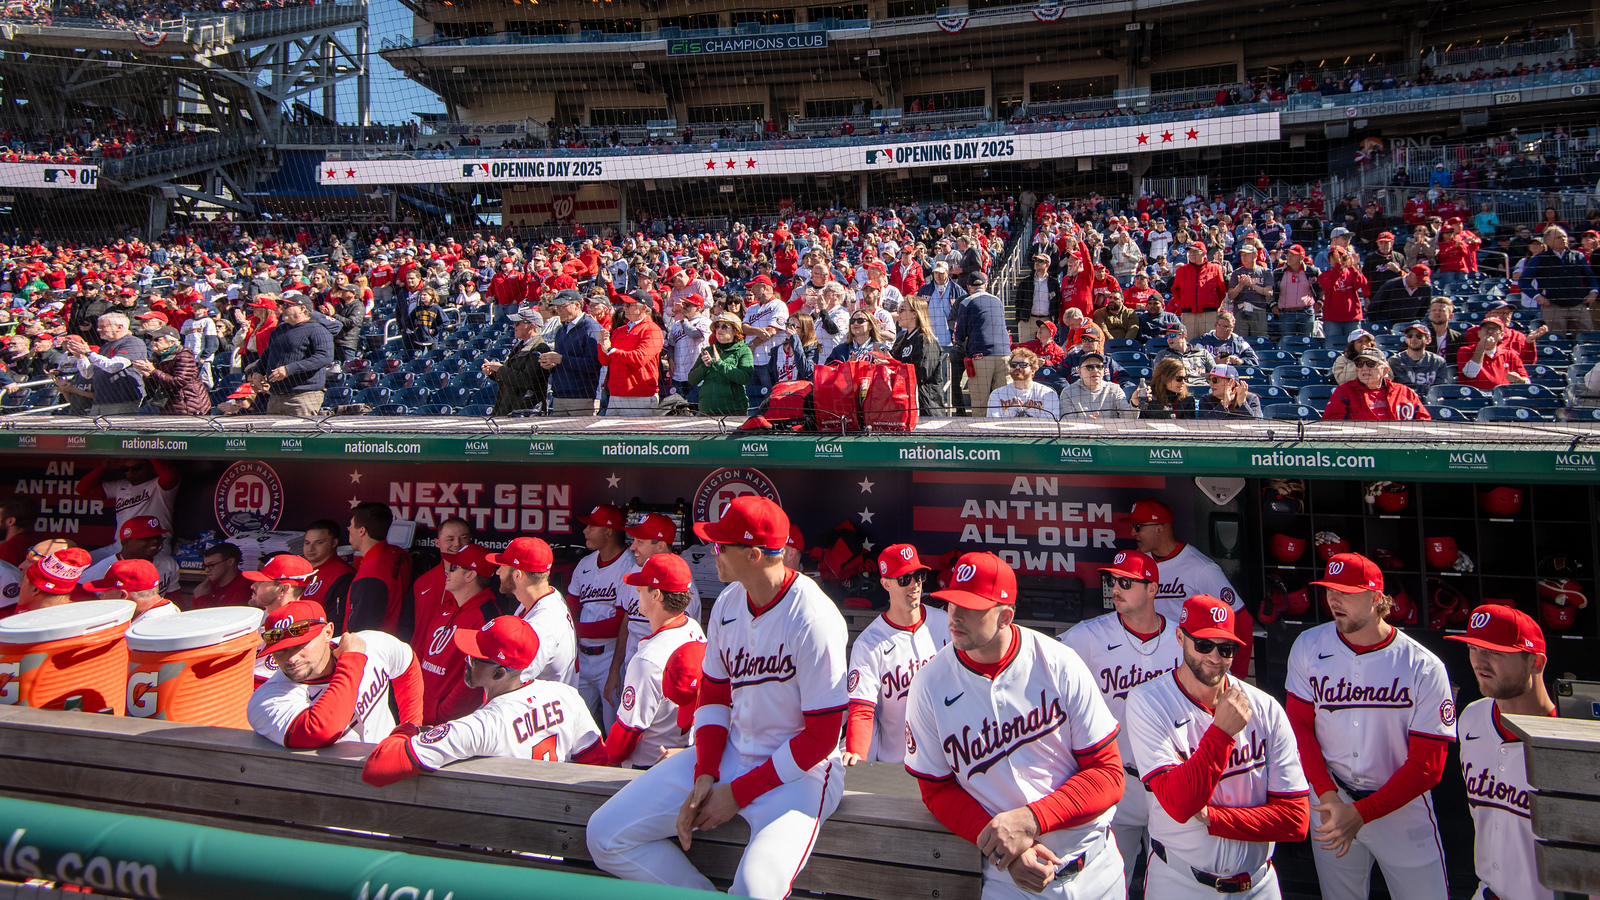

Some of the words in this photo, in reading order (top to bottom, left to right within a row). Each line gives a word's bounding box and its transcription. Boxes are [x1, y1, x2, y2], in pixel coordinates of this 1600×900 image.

[705, 38, 784, 52] CHAMPIONS
[788, 35, 823, 47] CLUB
[1499, 95, 1517, 103] 126
[1361, 101, 1432, 116] RODRIGUEZ
[896, 143, 951, 163] OPENING
[954, 141, 979, 160] DAY
[981, 139, 1014, 158] 2025
[491, 162, 545, 178] OPENING
[547, 161, 571, 177] DAY
[572, 160, 603, 176] 2025
[121, 438, 188, 450] nationals.com
[225, 439, 246, 447] MGM
[281, 439, 302, 447] MGM
[344, 441, 421, 453] nationals.com
[464, 442, 489, 450] MGM
[529, 442, 554, 451] MGM
[602, 442, 690, 455] nationals.com
[741, 443, 768, 452] MGM
[815, 443, 843, 453] MGM
[899, 445, 1000, 461] nationals.com
[1061, 447, 1092, 457] MGM
[1149, 449, 1182, 459] MGM
[1251, 450, 1376, 468] nationals.com
[1449, 453, 1487, 463] MGM
[1555, 454, 1595, 465] MGM
[46, 461, 75, 476] AN
[217, 463, 254, 520] WASHINGTON
[256, 465, 281, 521] NATIONALS
[389, 481, 485, 507] NEXT
[494, 483, 572, 508] GEN
[745, 471, 775, 502] NATIO
[1010, 476, 1059, 496] AN
[235, 481, 263, 509] 20
[58, 499, 104, 516] OUR
[960, 499, 1113, 524] ANTHEM
[34, 517, 80, 533] OWN
[389, 505, 573, 534] NATITUDE
[959, 523, 1028, 545] ALL
[1038, 526, 1117, 549] OUR
[900, 546, 914, 560] W
[998, 549, 1076, 573] OWN
[1113, 551, 1127, 565] W
[180, 560, 204, 569] GIANTS
[956, 563, 977, 583] W
[1328, 561, 1345, 576] W
[1210, 606, 1228, 623] W
[1470, 612, 1491, 629] W
[428, 624, 458, 656] W
[422, 658, 447, 676] NATIONALS
[126, 671, 159, 718] G
[356, 666, 390, 716] onals
[1309, 675, 1414, 706] Nationals
[512, 700, 565, 744] COLES
[943, 689, 1068, 774] Nationals
[1242, 881, 1251, 890] 32
